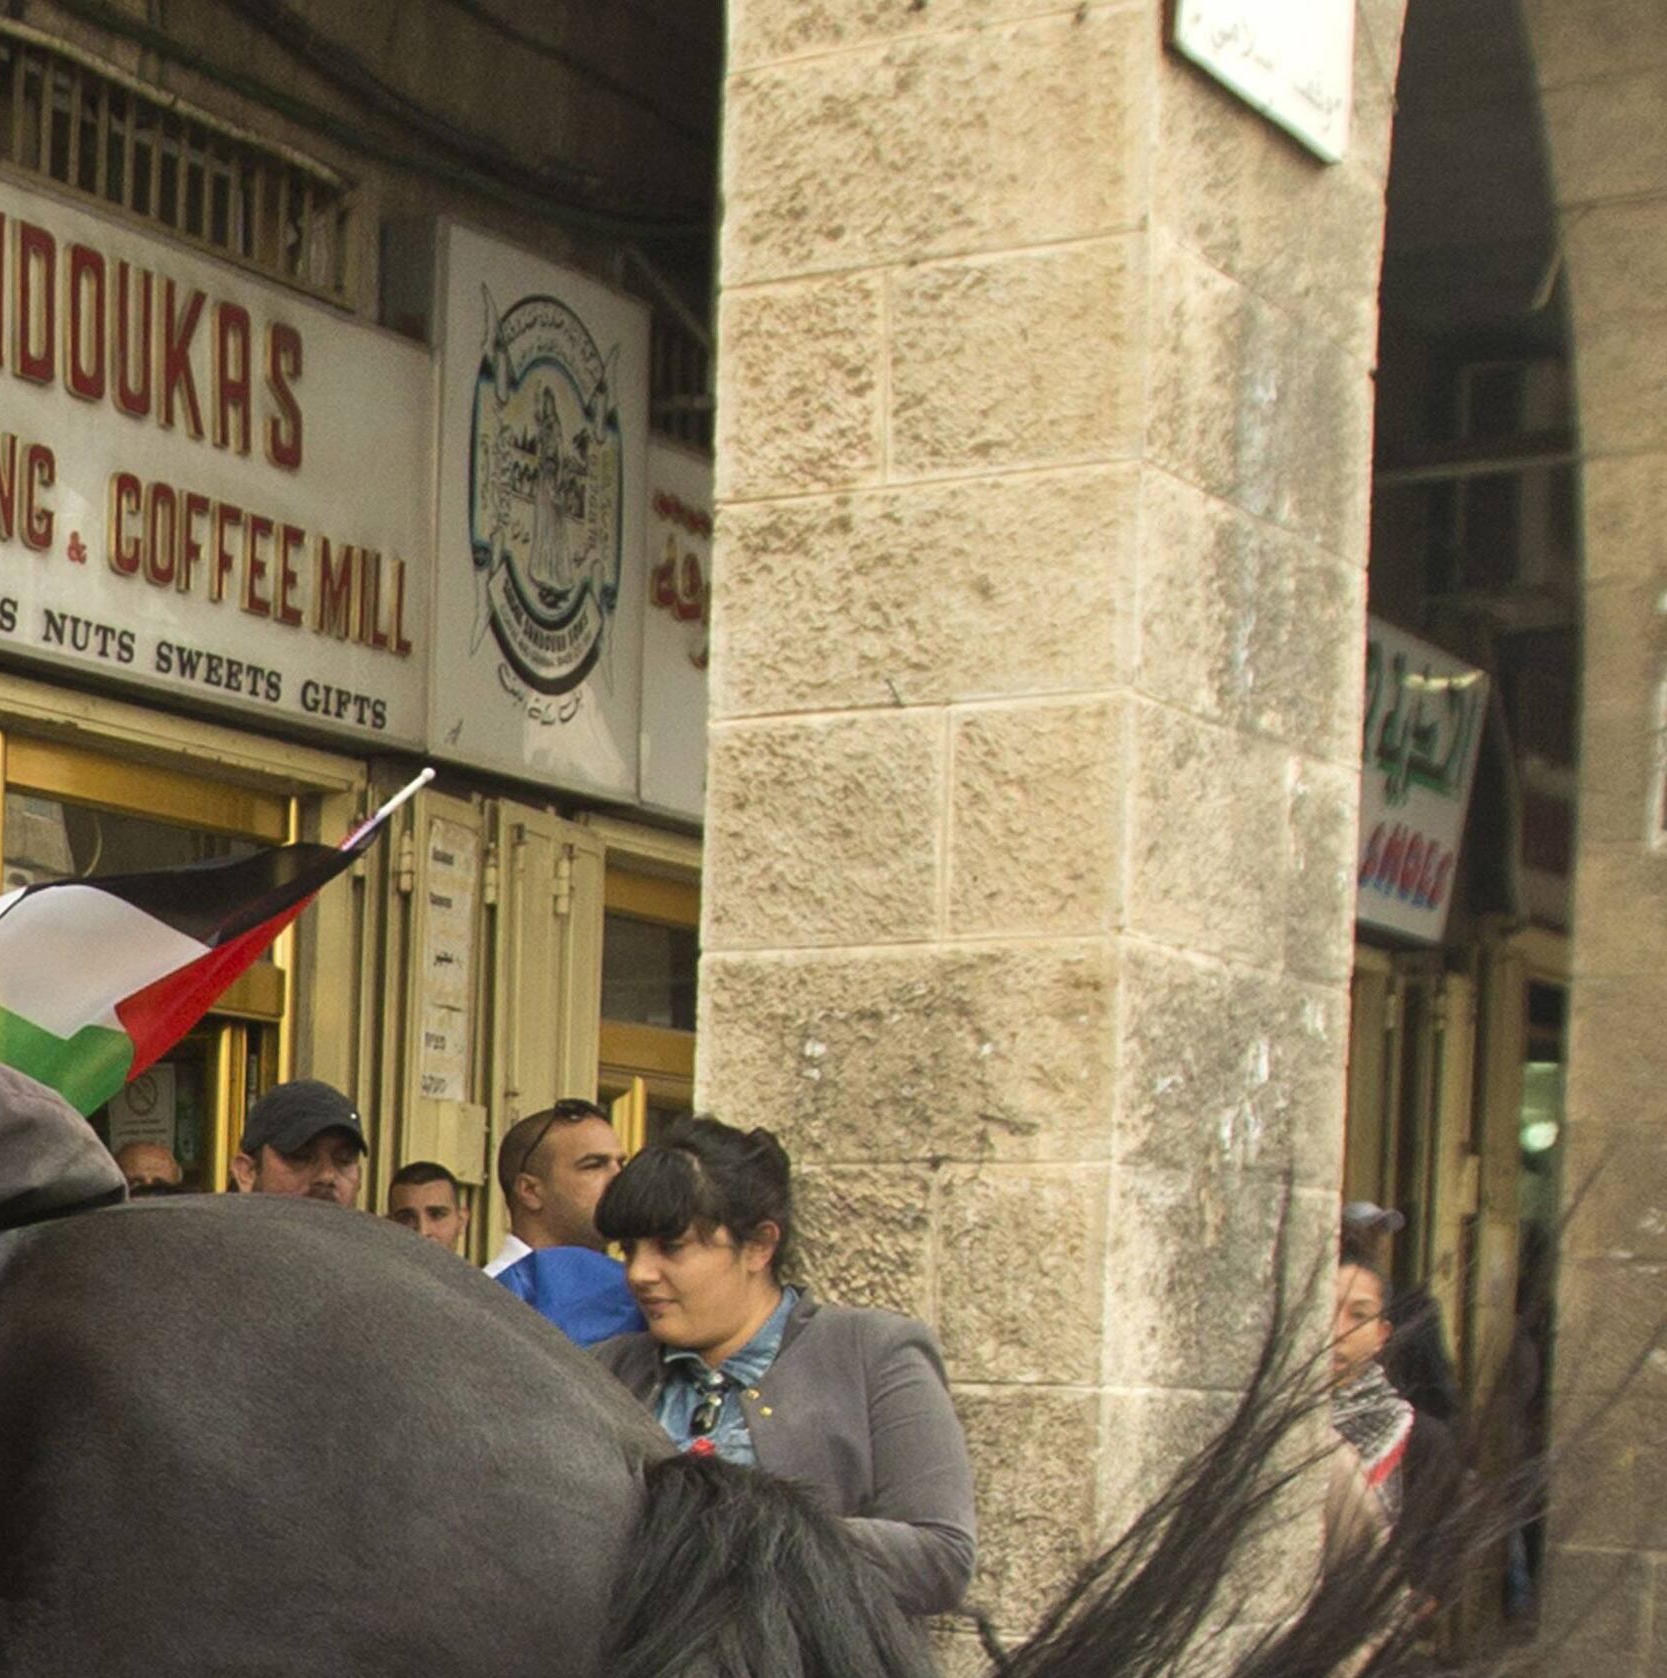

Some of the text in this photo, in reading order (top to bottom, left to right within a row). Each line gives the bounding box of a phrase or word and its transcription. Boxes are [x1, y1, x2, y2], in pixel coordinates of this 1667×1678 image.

[66, 531, 87, 564] &
[107, 471, 306, 628] COFFEE
[312, 533, 413, 658] MILL
[42, 608, 136, 665] NUTS
[154, 640, 282, 703] SWEETS
[299, 679, 388, 730] GIFTS
